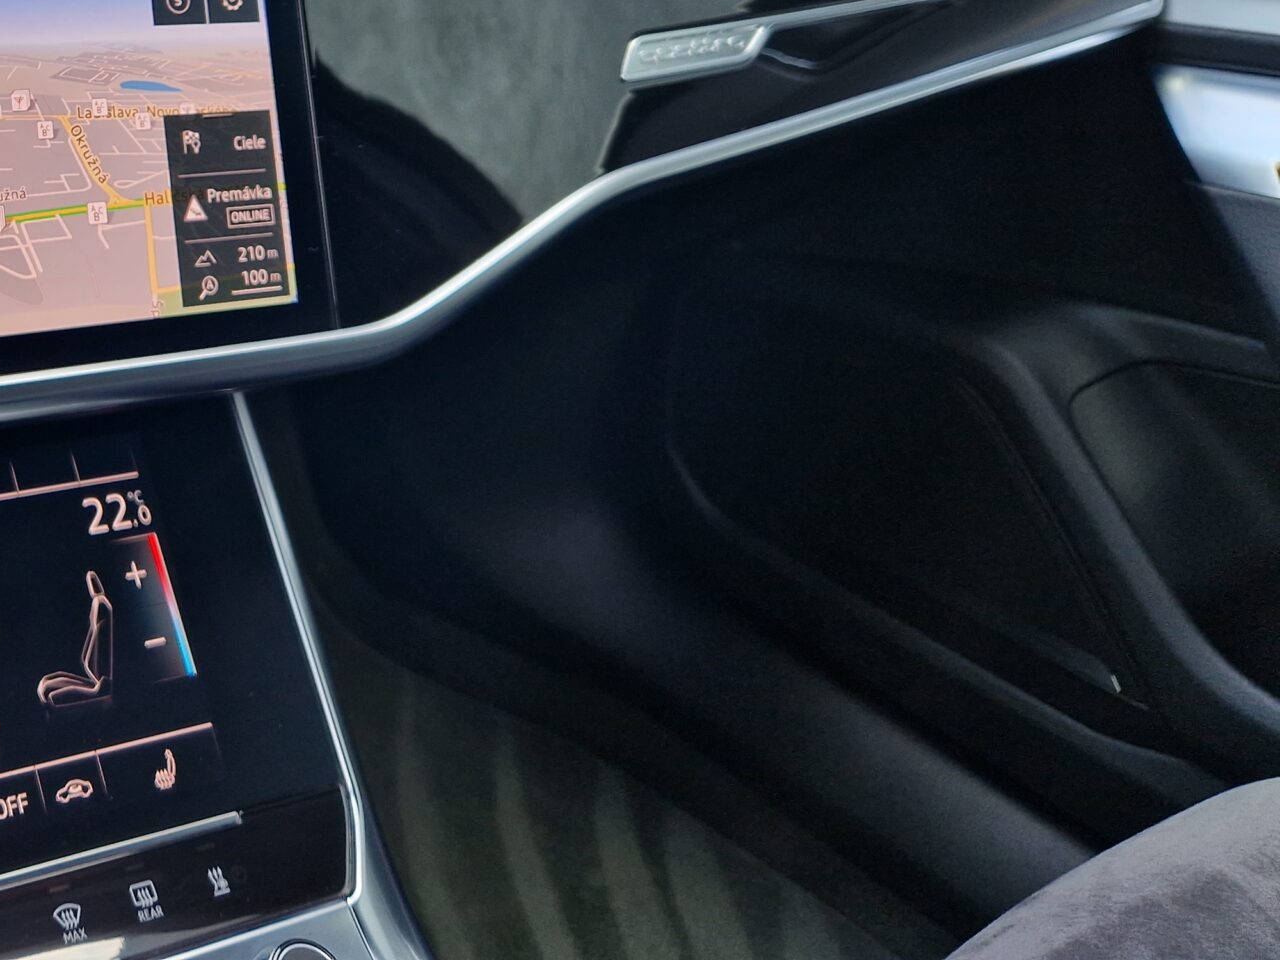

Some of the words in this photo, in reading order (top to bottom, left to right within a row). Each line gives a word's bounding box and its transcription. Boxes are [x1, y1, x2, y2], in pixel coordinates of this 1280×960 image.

[77, 104, 139, 119] Laslava
[233, 134, 267, 151] Ciele
[70, 124, 108, 185] Okružná
[207, 184, 273, 204] Premávka
[230, 209, 271, 224] ONLINE
[238, 245, 266, 263] 210
[266, 248, 279, 259] m
[241, 268, 269, 286] 100
[270, 272, 282, 282] m
[137, 905, 165, 923] REAR
[62, 926, 88, 945] MAX
